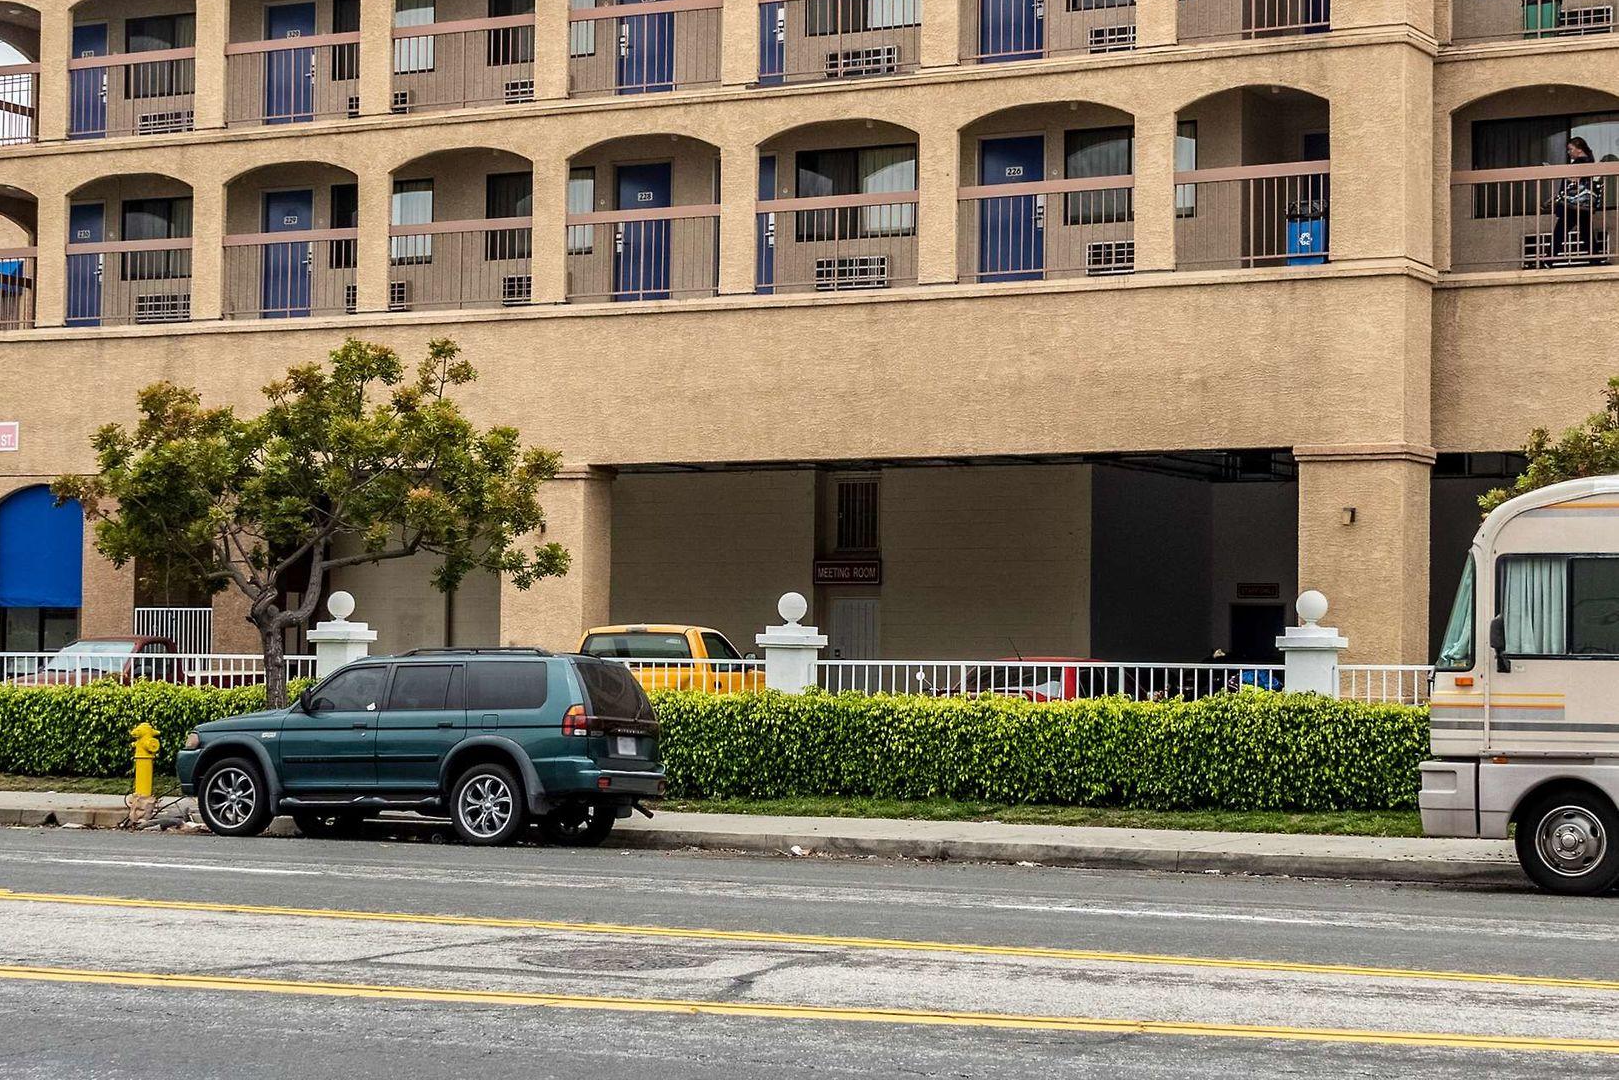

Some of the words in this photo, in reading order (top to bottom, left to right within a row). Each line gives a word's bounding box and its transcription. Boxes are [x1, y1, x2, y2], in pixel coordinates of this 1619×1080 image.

[1007, 167, 1022, 176] 226
[1, 434, 15, 446] ST.
[818, 567, 850, 578] MEETING
[853, 567, 876, 578] ROOM
